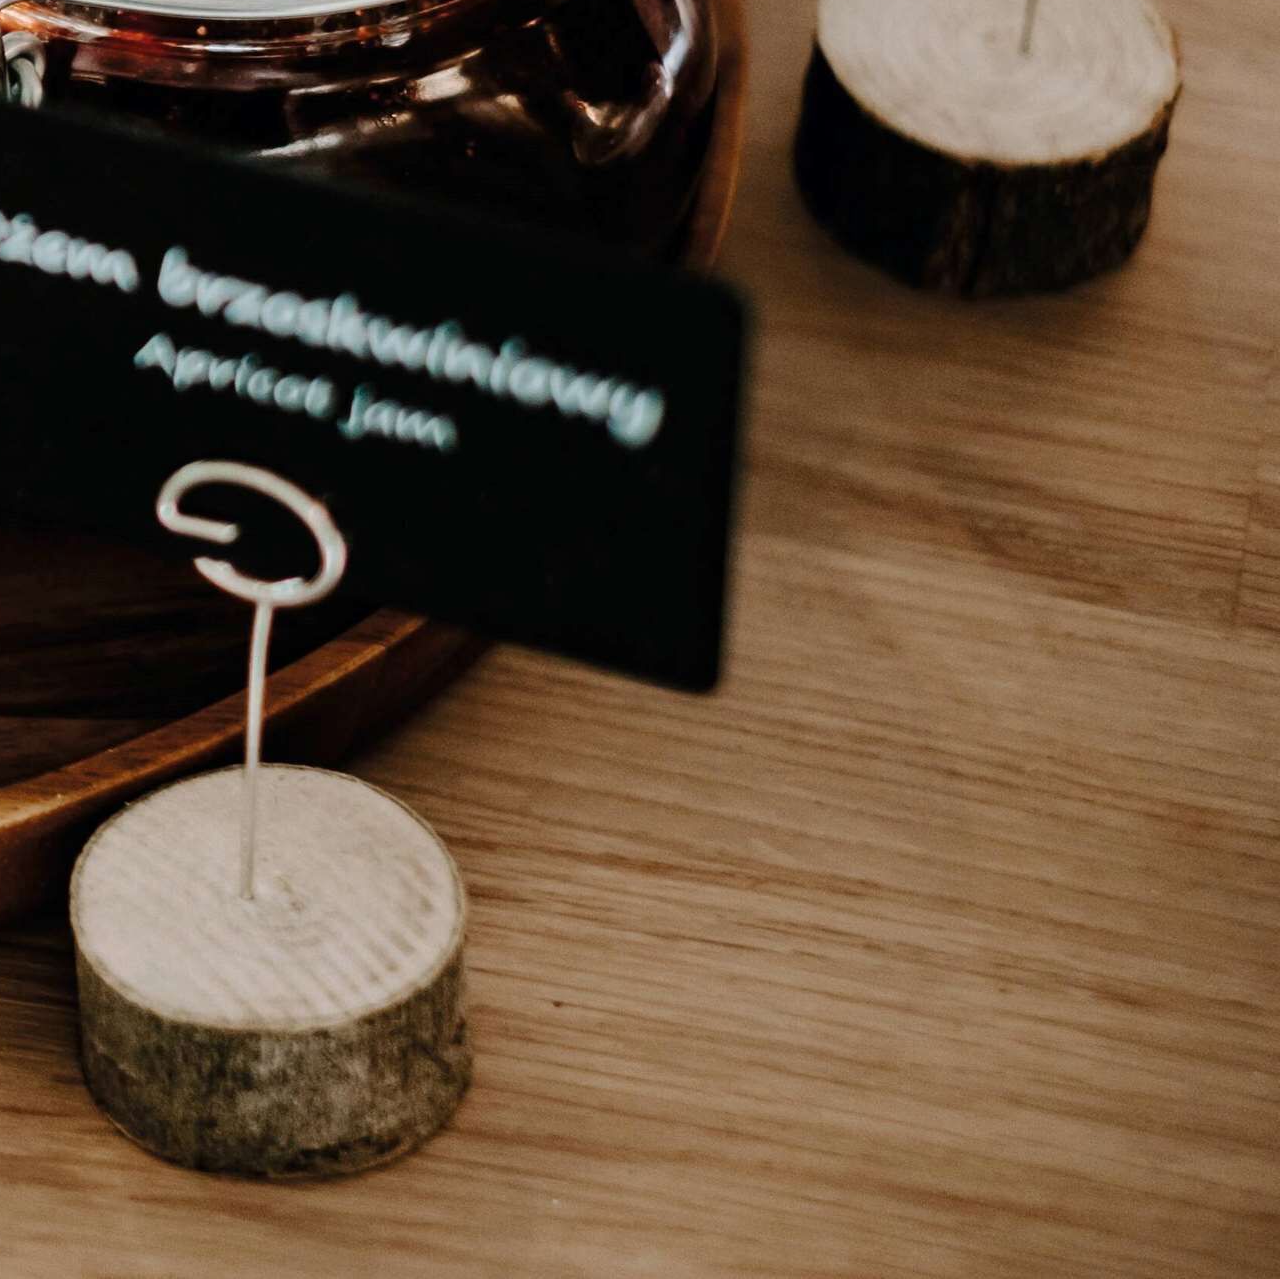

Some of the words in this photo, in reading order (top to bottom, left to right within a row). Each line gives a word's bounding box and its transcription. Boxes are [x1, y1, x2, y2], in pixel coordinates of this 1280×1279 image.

[133, 332, 335, 419] Apricot
[336, 385, 458, 451] jam
[156, 245, 666, 447] brzoskwiniowy
